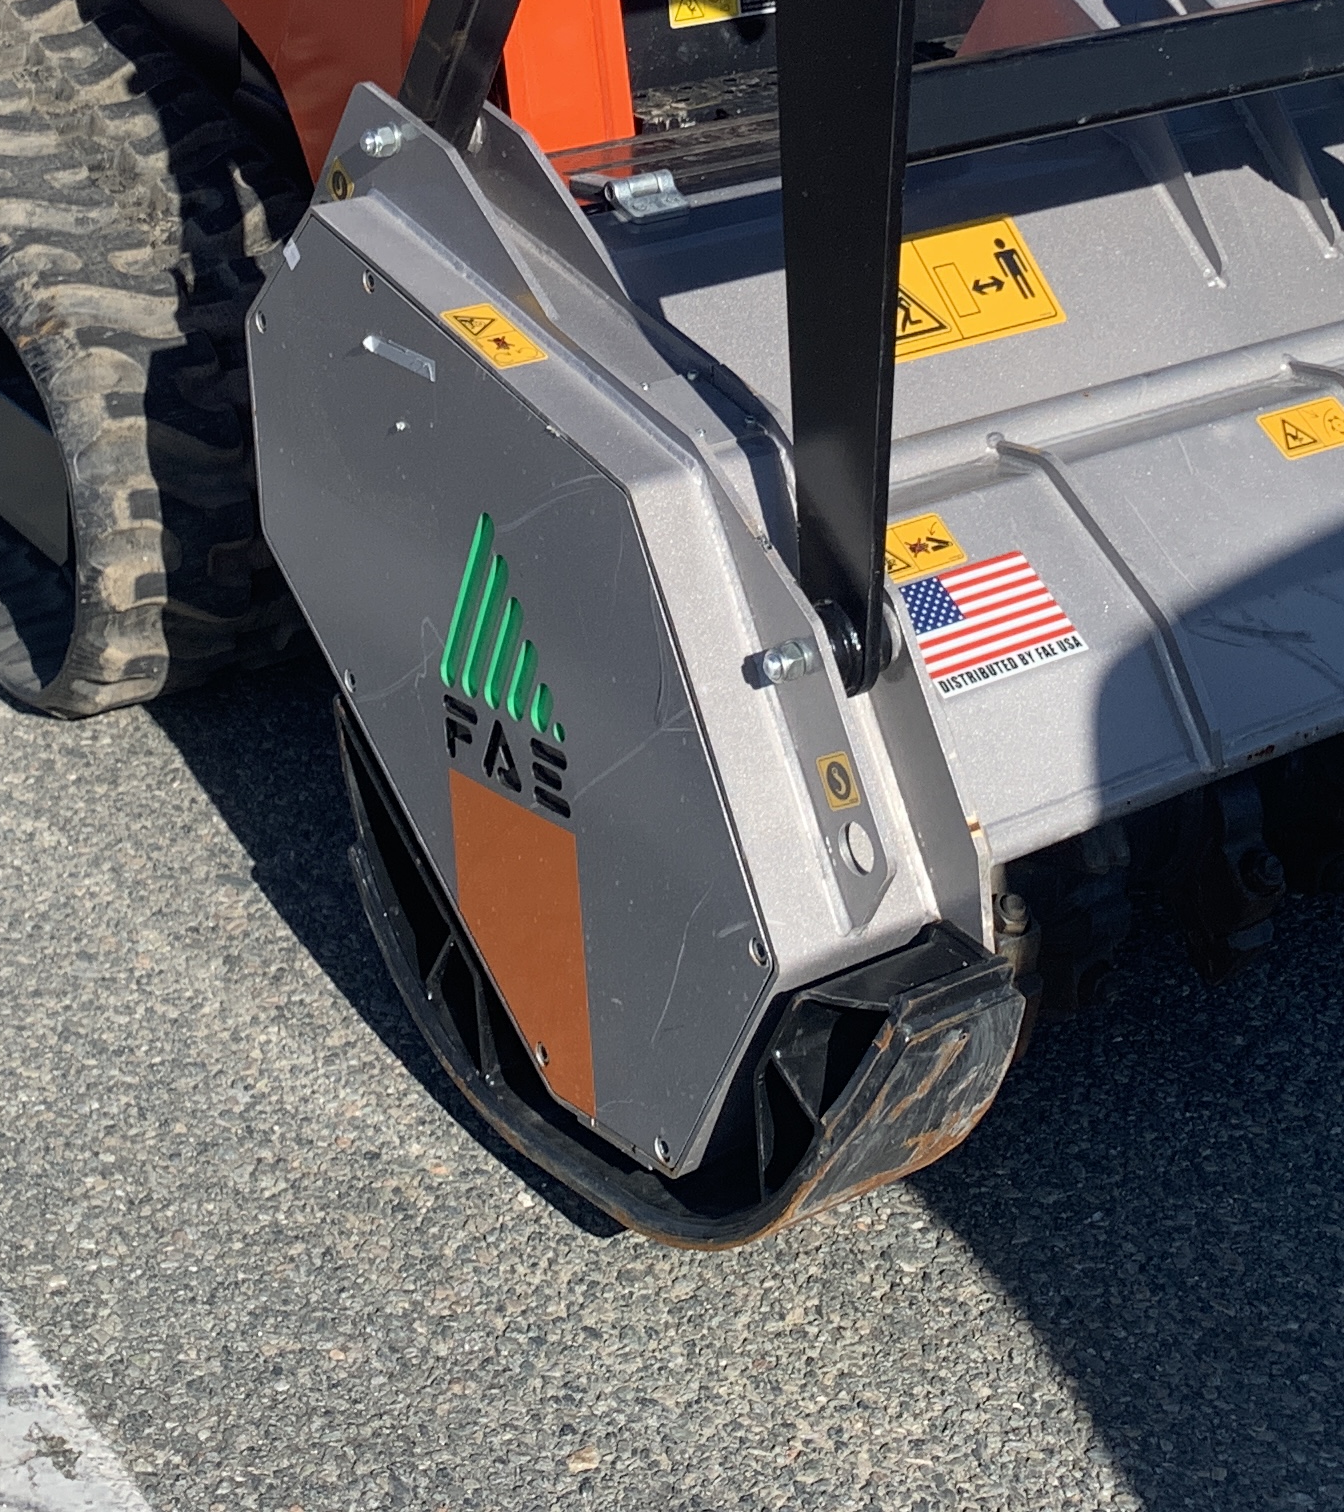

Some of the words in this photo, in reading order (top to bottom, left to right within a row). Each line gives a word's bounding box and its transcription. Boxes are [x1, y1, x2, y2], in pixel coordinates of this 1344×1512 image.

[938, 657, 1018, 694] DISTRIBUTED
[1017, 652, 1036, 666] BY
[1035, 646, 1058, 660] FAE
[1056, 635, 1084, 653] USA
[443, 694, 571, 819] FAE
